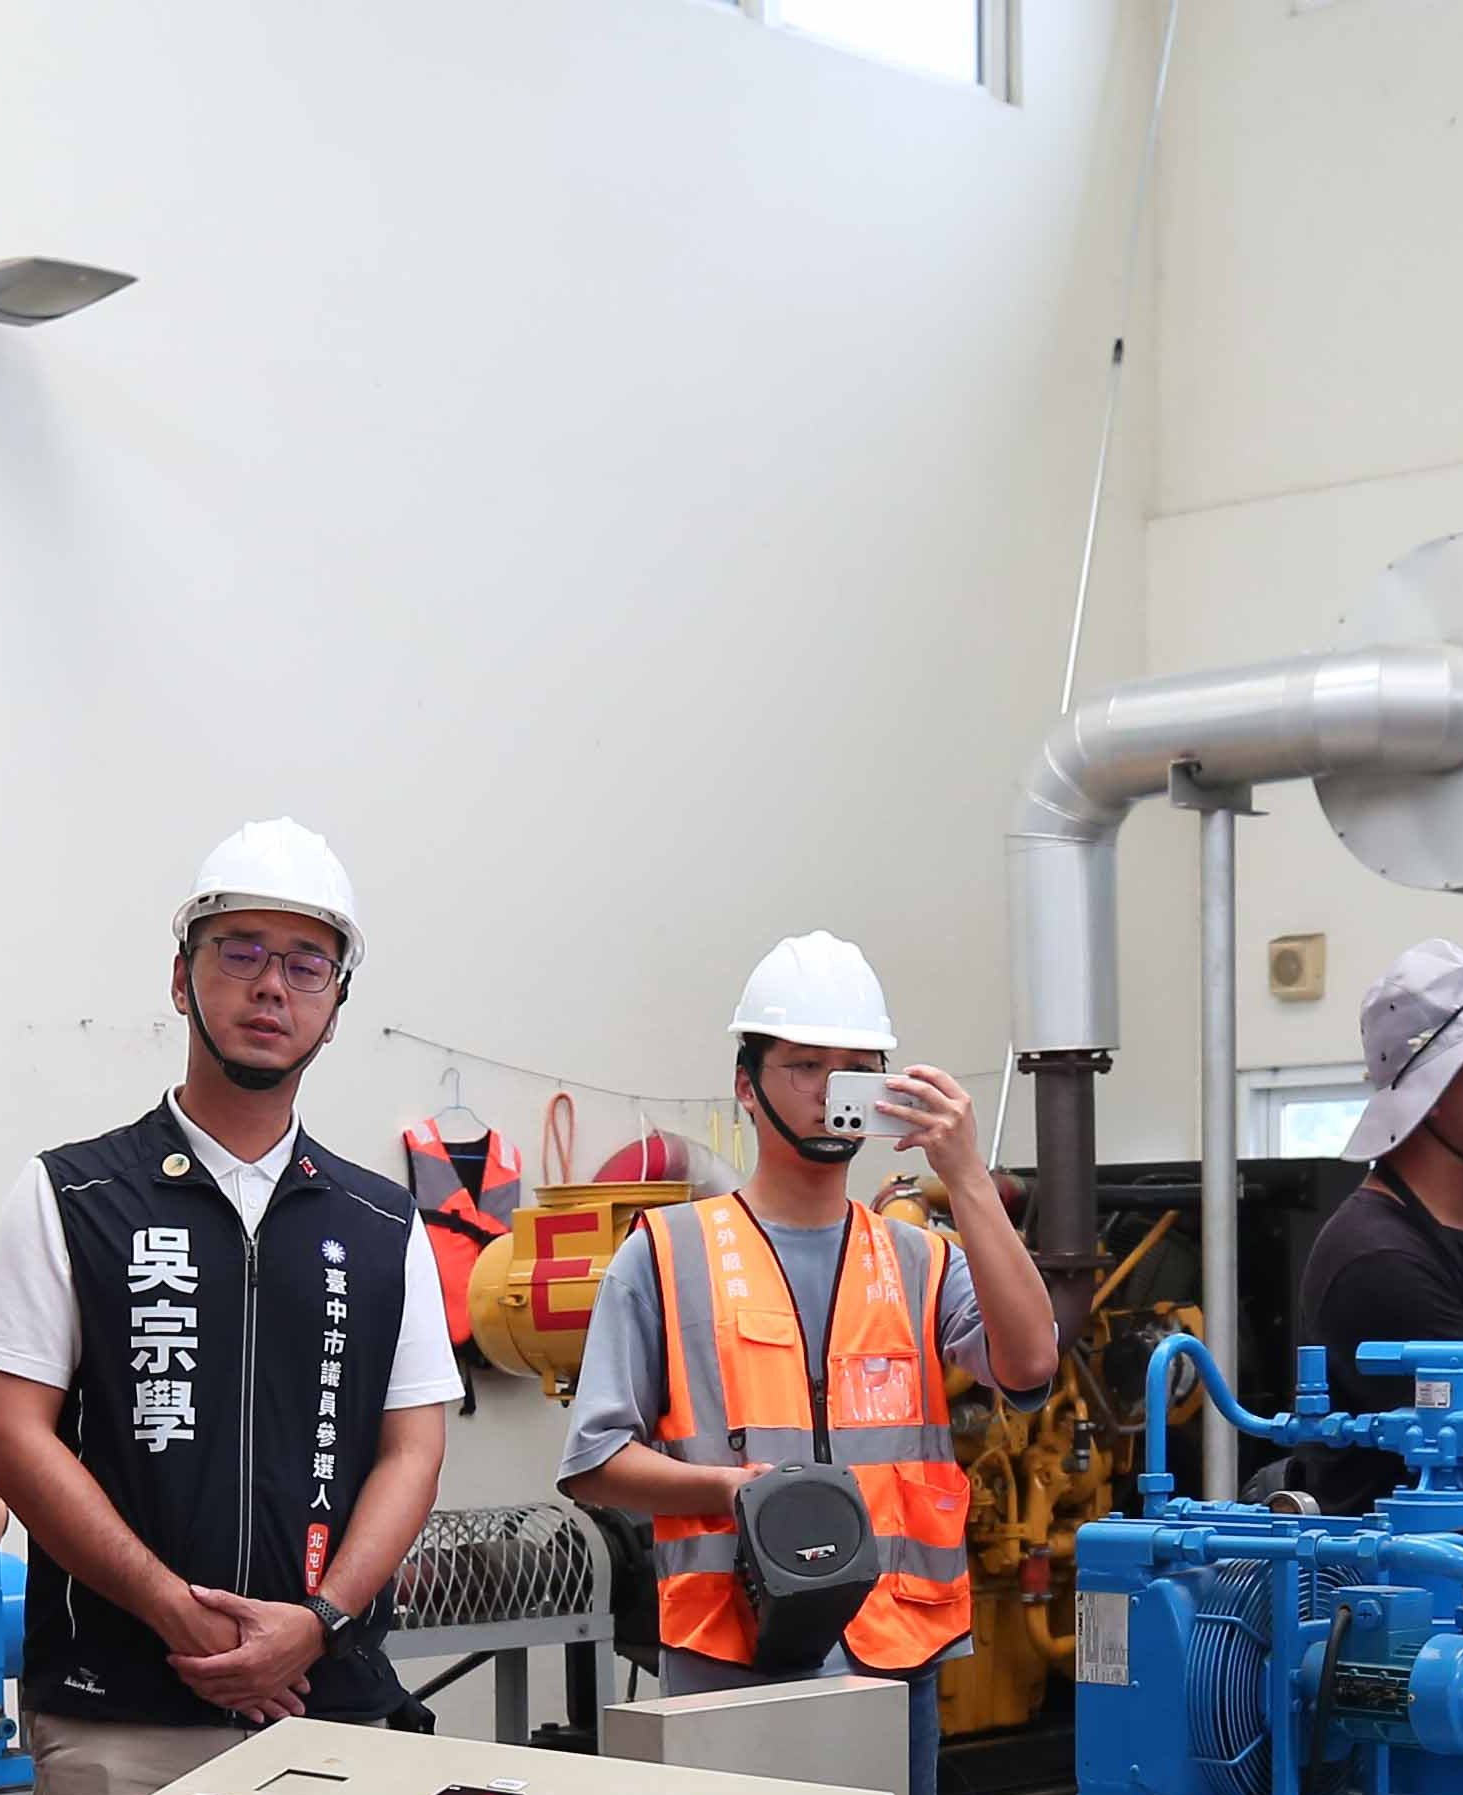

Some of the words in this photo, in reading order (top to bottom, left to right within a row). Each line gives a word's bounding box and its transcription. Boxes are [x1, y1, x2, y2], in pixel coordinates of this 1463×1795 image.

[127, 1227, 199, 1453] 吳宗學
[531, 1211, 599, 1332] E
[300, 1268, 347, 1511] 臺中市議員參選人
